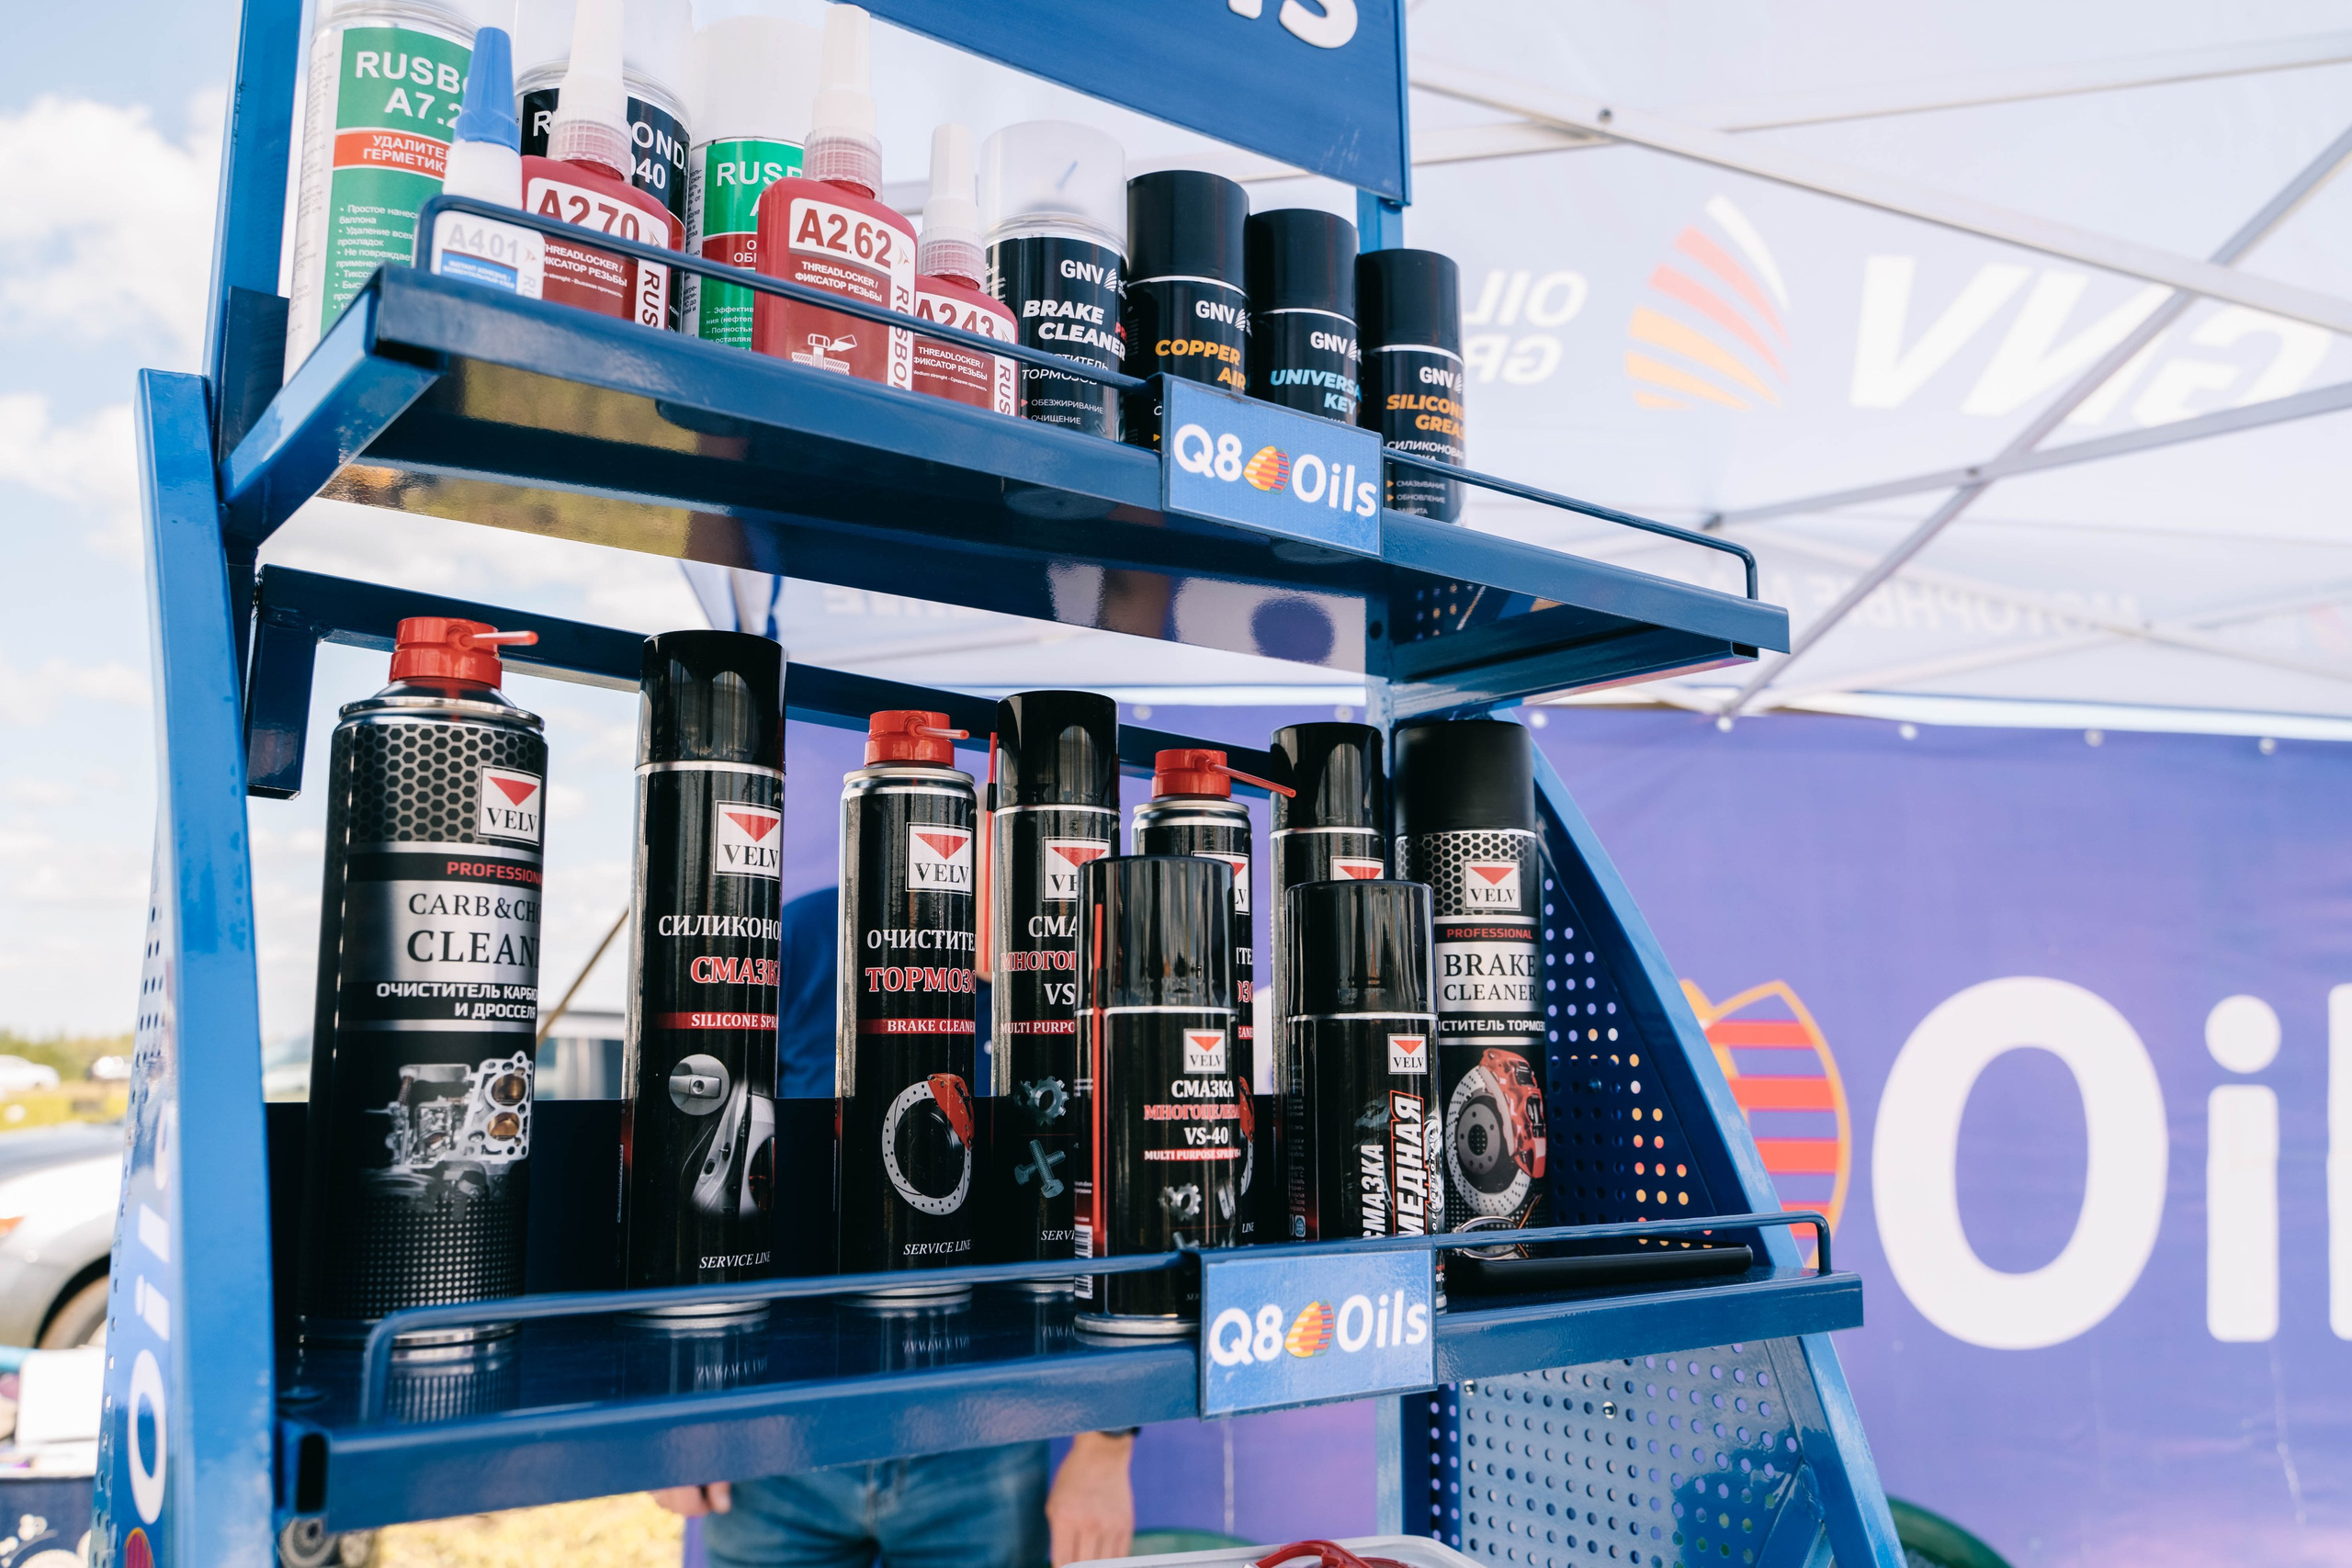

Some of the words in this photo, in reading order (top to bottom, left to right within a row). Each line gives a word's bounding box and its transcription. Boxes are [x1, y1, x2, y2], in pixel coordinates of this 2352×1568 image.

[355, 51, 468, 95] RUSB
[363, 147, 447, 174] ГЕРМЕТИК
[588, 266, 628, 288] РЕЗЬБЫ
[801, 261, 875, 288] THREADLOCKER
[1060, 259, 1104, 285] GNV
[795, 272, 846, 290] ФИКСАТОР
[847, 283, 882, 303] РЕЗЬБЫ
[1023, 299, 1104, 325] BRAKE
[1195, 299, 1236, 325] GNV
[1037, 321, 1126, 362] CLEANER
[1155, 338, 1241, 367] COPPER
[1309, 331, 1348, 355] GNV
[918, 346, 981, 368] THREADLOCKER
[957, 364, 988, 381] РЕЗЬБЫ
[1216, 367, 1247, 391] AIR
[1419, 366, 1454, 389] GNV
[1031, 399, 1103, 414] ОБЕЗЖИРИВАНИЕ
[1324, 392, 1357, 415] KEY
[1173, 423, 1243, 482] Q8
[1291, 453, 1378, 518] Oils
[1396, 479, 1446, 491] СМАЗЫВАНИЕ
[1396, 494, 1446, 504] ОБНОВЛЕНИЕ
[485, 807, 537, 834] VELV
[722, 843, 779, 870] VELV
[913, 862, 969, 885] VELV
[1469, 887, 1517, 903] VELV
[659, 915, 781, 941] СИЛИКОНО
[1446, 928, 1533, 940] PROFESSIONAL
[407, 930, 539, 969] CLEAN
[866, 929, 976, 952] ОЧИСТИТЕ
[1443, 953, 1536, 977] BRAKE
[377, 982, 501, 999] ОЧИСТИТЕЛЬ
[1443, 983, 1537, 1001] CLEANER
[455, 1002, 469, 1017] И
[691, 1013, 758, 1028] SILICONE
[888, 1020, 936, 1032] BRAKE
[1190, 1054, 1224, 1068] VELV
[1393, 1056, 1424, 1069] VELV
[1171, 1078, 1235, 1099] СМАЗКА
[1183, 1126, 1229, 1146] VS-40
[1144, 1150, 1176, 1161] MULTI
[1176, 1149, 1216, 1161] PURPOSE
[903, 1241, 954, 1256] SERVICE
[955, 1238, 971, 1252] LINE
[699, 1253, 753, 1269] SERVICE
[754, 1250, 771, 1265] LINE
[1208, 1303, 1284, 1367] Q8
[1336, 1290, 1428, 1353] Oils
